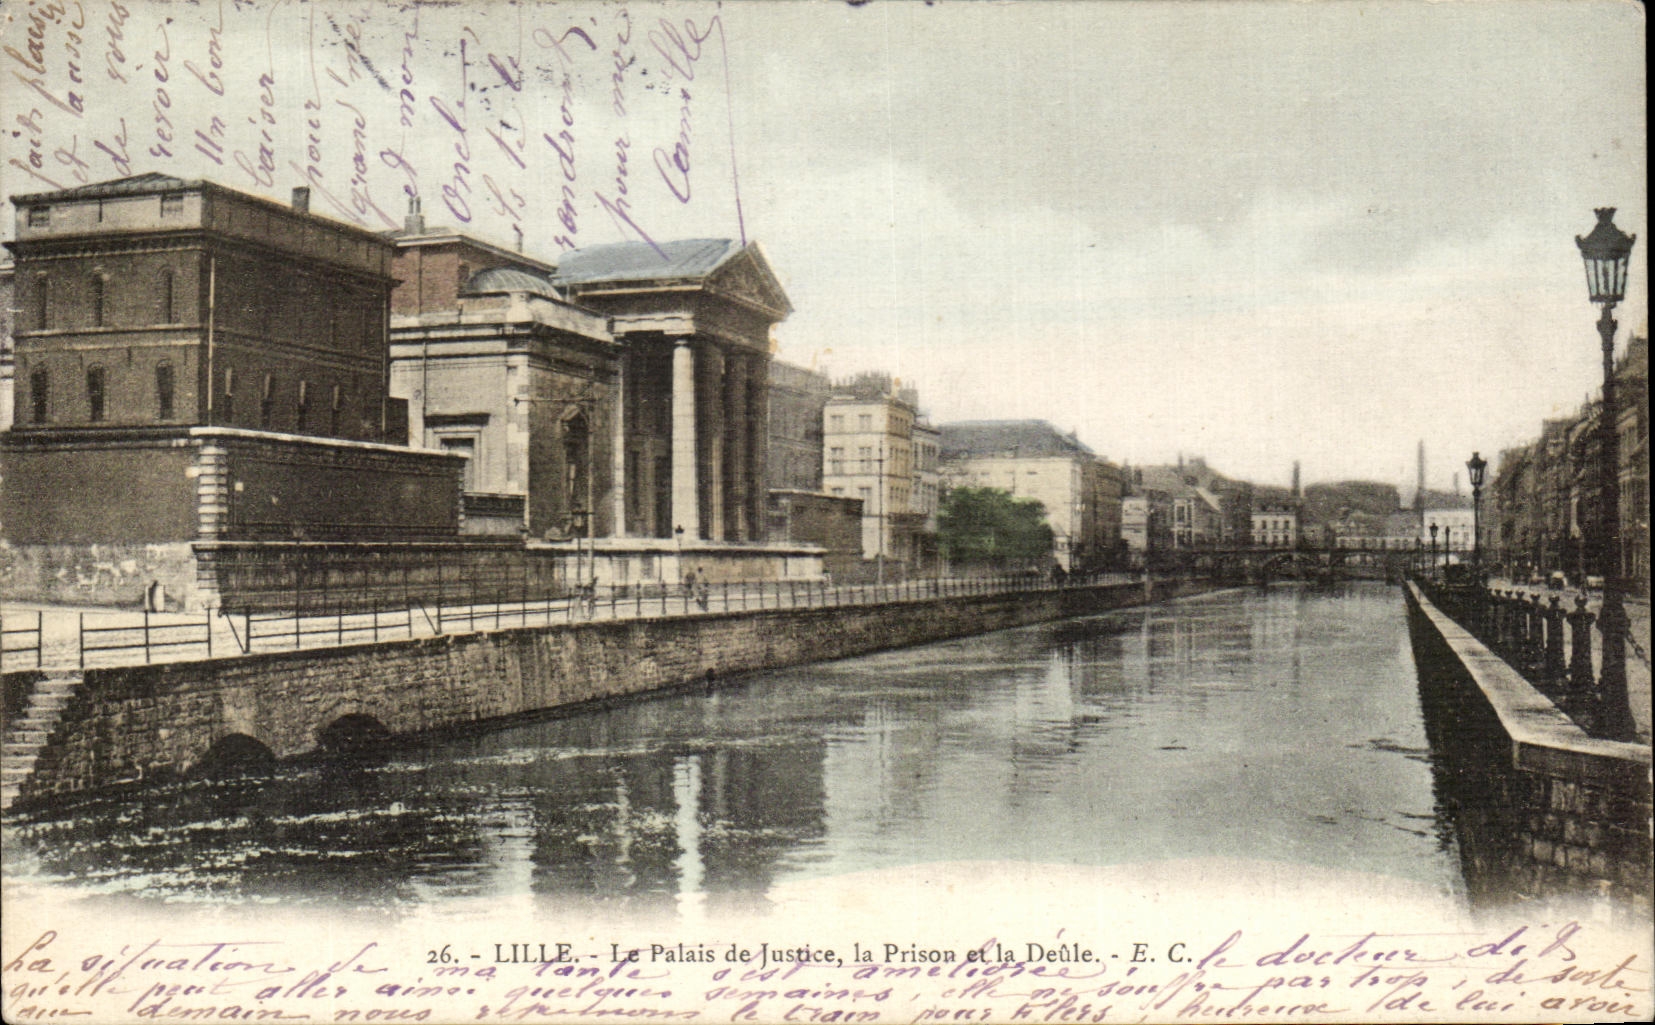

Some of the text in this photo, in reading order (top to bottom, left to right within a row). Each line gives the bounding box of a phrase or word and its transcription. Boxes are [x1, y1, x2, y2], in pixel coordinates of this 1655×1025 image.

[183, 3, 224, 96] bon
[399, 14, 420, 128] mon
[611, 8, 632, 118] moi
[94, 118, 131, 176] de
[233, 38, 276, 188] baiser
[647, 15, 722, 206] Camille
[594, 137, 671, 261] pour
[81, 939, 296, 972] situation
[328, 942, 388, 973] de
[433, 966, 497, 978] ma
[531, 950, 672, 979] tante
[1256, 932, 1457, 967] docteur
[255, 970, 348, 1000] aller
[501, 976, 673, 1014] quelques
[1228, 975, 1331, 1014] pas
[1485, 958, 1528, 984] de
[1551, 954, 1650, 992] sorte
[136, 997, 310, 1021] demain
[334, 1009, 433, 1022] nous
[730, 1000, 760, 1022] le
[783, 1003, 881, 1023] train
[908, 1006, 992, 1024] pour
[1384, 991, 1437, 1011] de
[1456, 989, 1525, 1012] lui
[1540, 992, 1641, 1018] avoir
